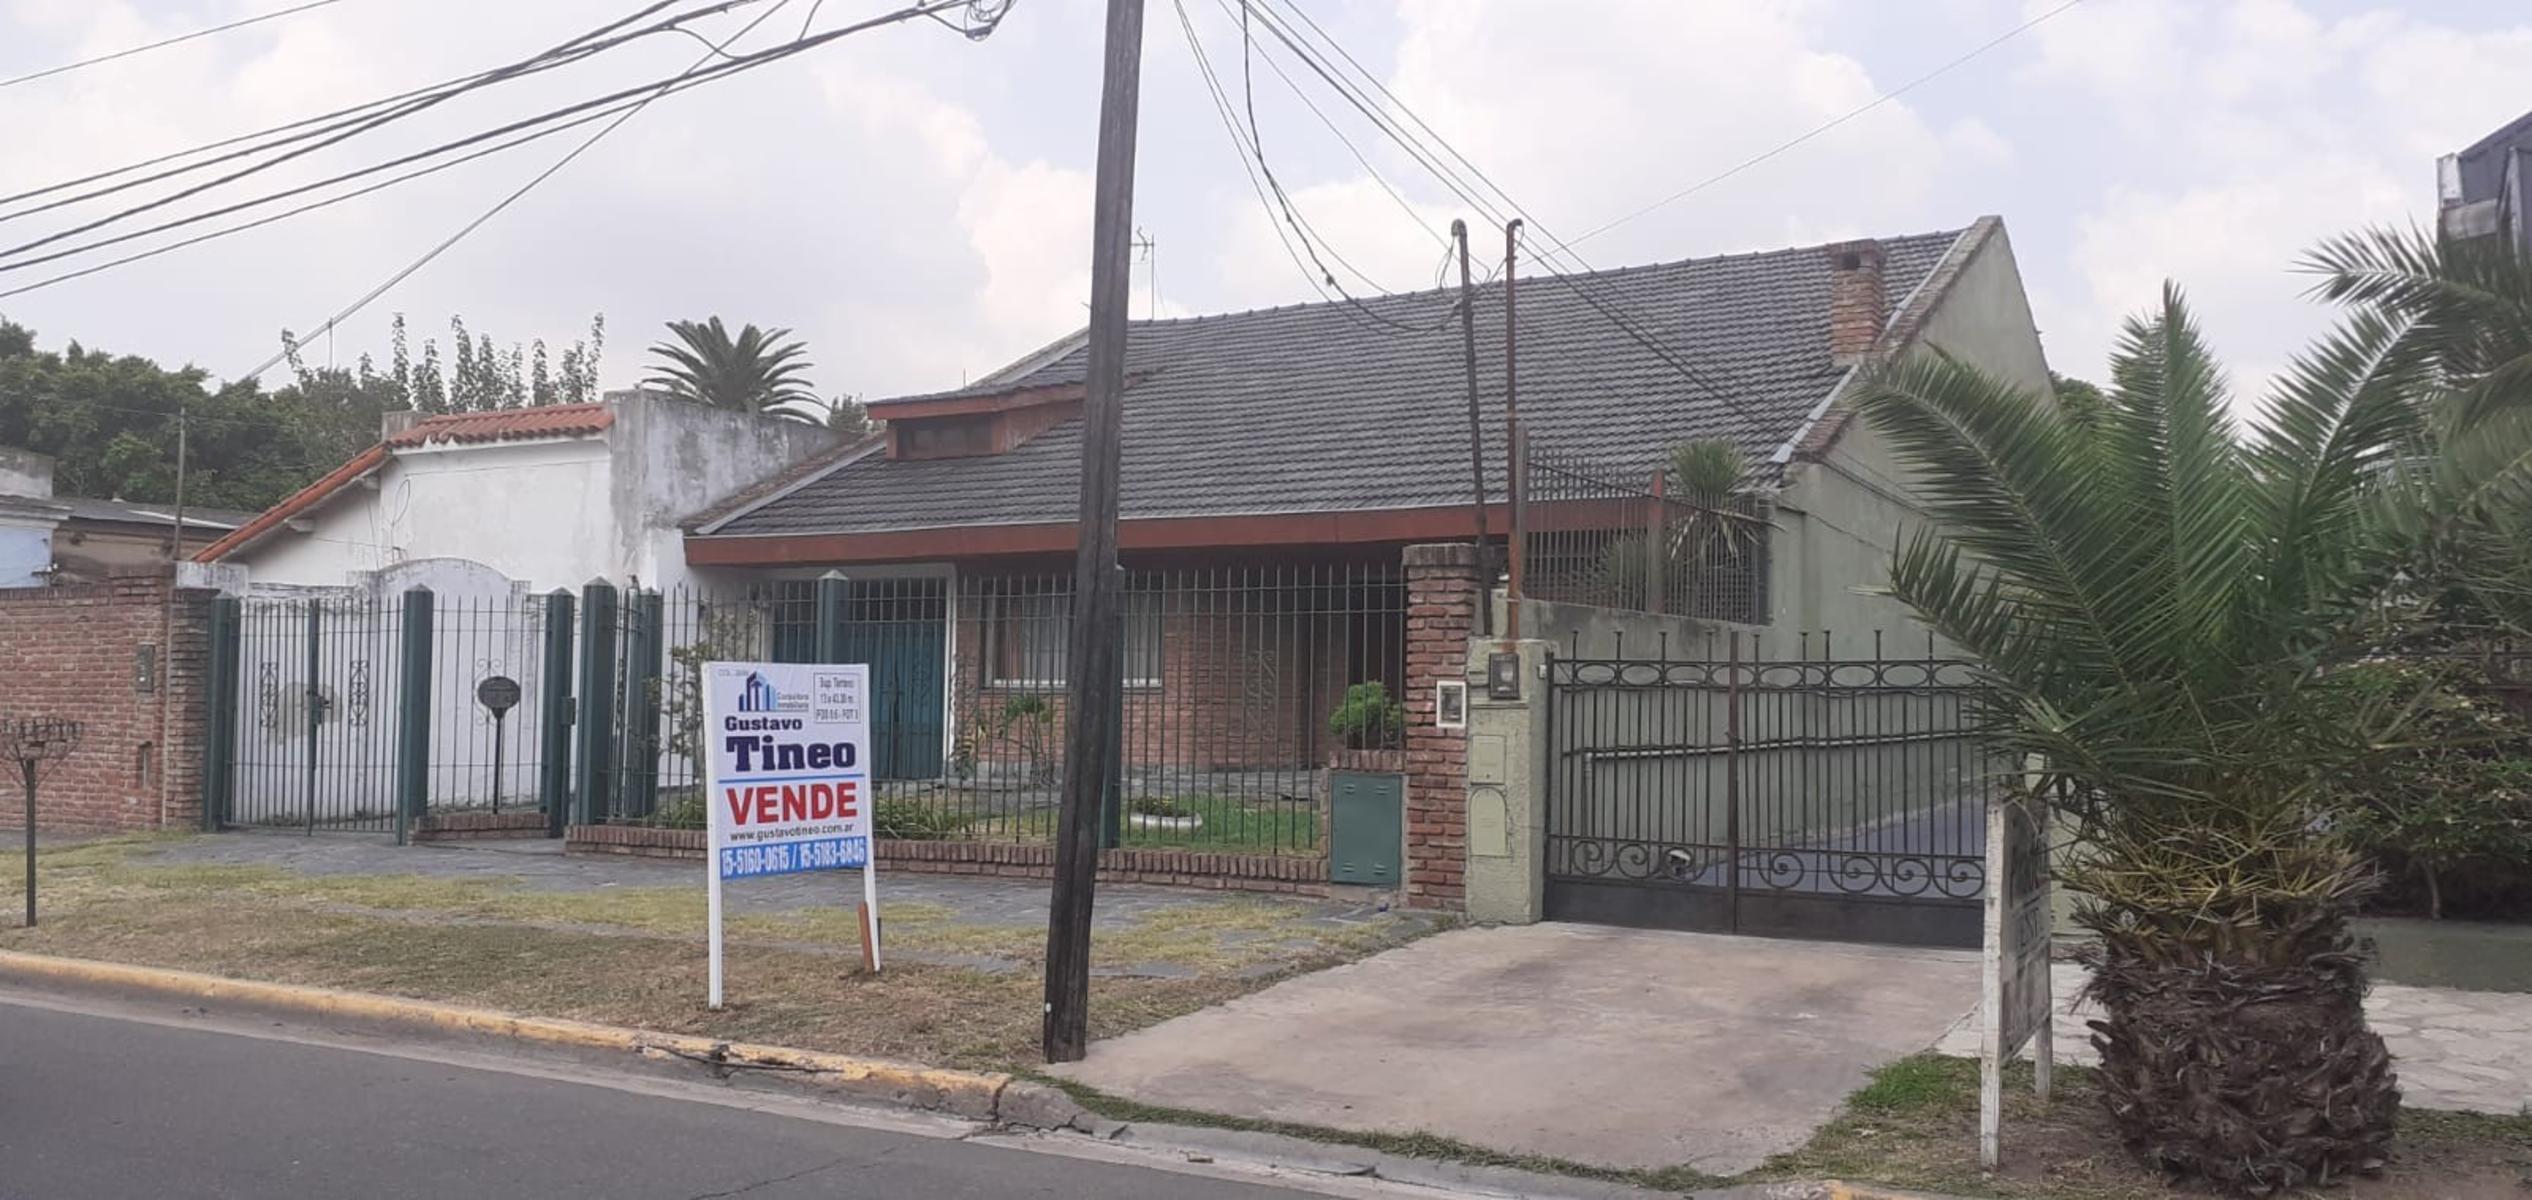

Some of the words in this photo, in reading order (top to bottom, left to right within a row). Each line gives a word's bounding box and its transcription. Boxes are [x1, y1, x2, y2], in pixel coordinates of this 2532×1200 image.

[725, 715, 803, 731] Gustavo
[726, 735, 856, 772] Tineo
[726, 782, 858, 826] VENDE
[730, 824, 854, 841] www.gustavotineo.com.ar
[722, 845, 789, 877] 15-5160-0615
[792, 843, 797, 869] /
